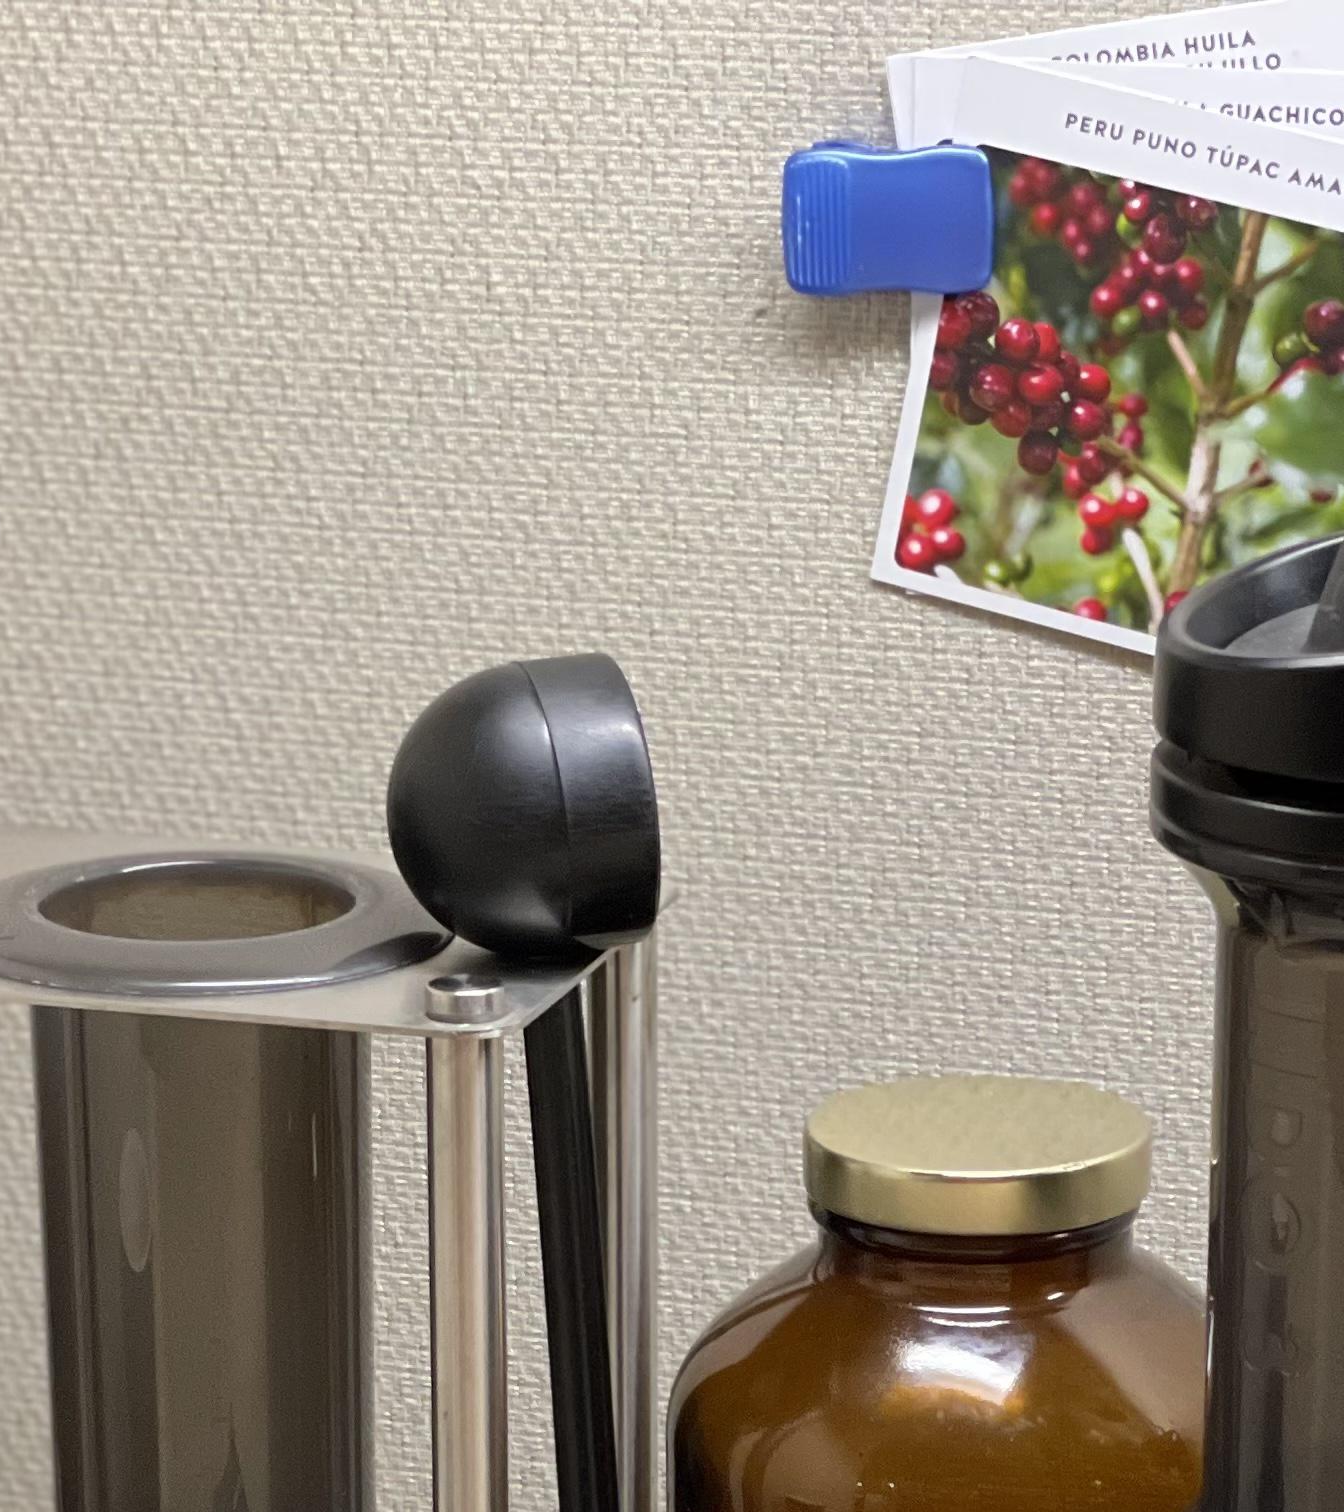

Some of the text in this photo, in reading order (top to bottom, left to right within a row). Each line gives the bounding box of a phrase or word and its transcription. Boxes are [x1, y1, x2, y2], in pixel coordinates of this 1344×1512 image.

[1052, 42, 1176, 64] OMBIA
[1184, 29, 1257, 56] HUILA
[1065, 112, 1124, 141] PERU
[1132, 128, 1196, 159] PUNO
[1206, 145, 1281, 179] TÚPAC
